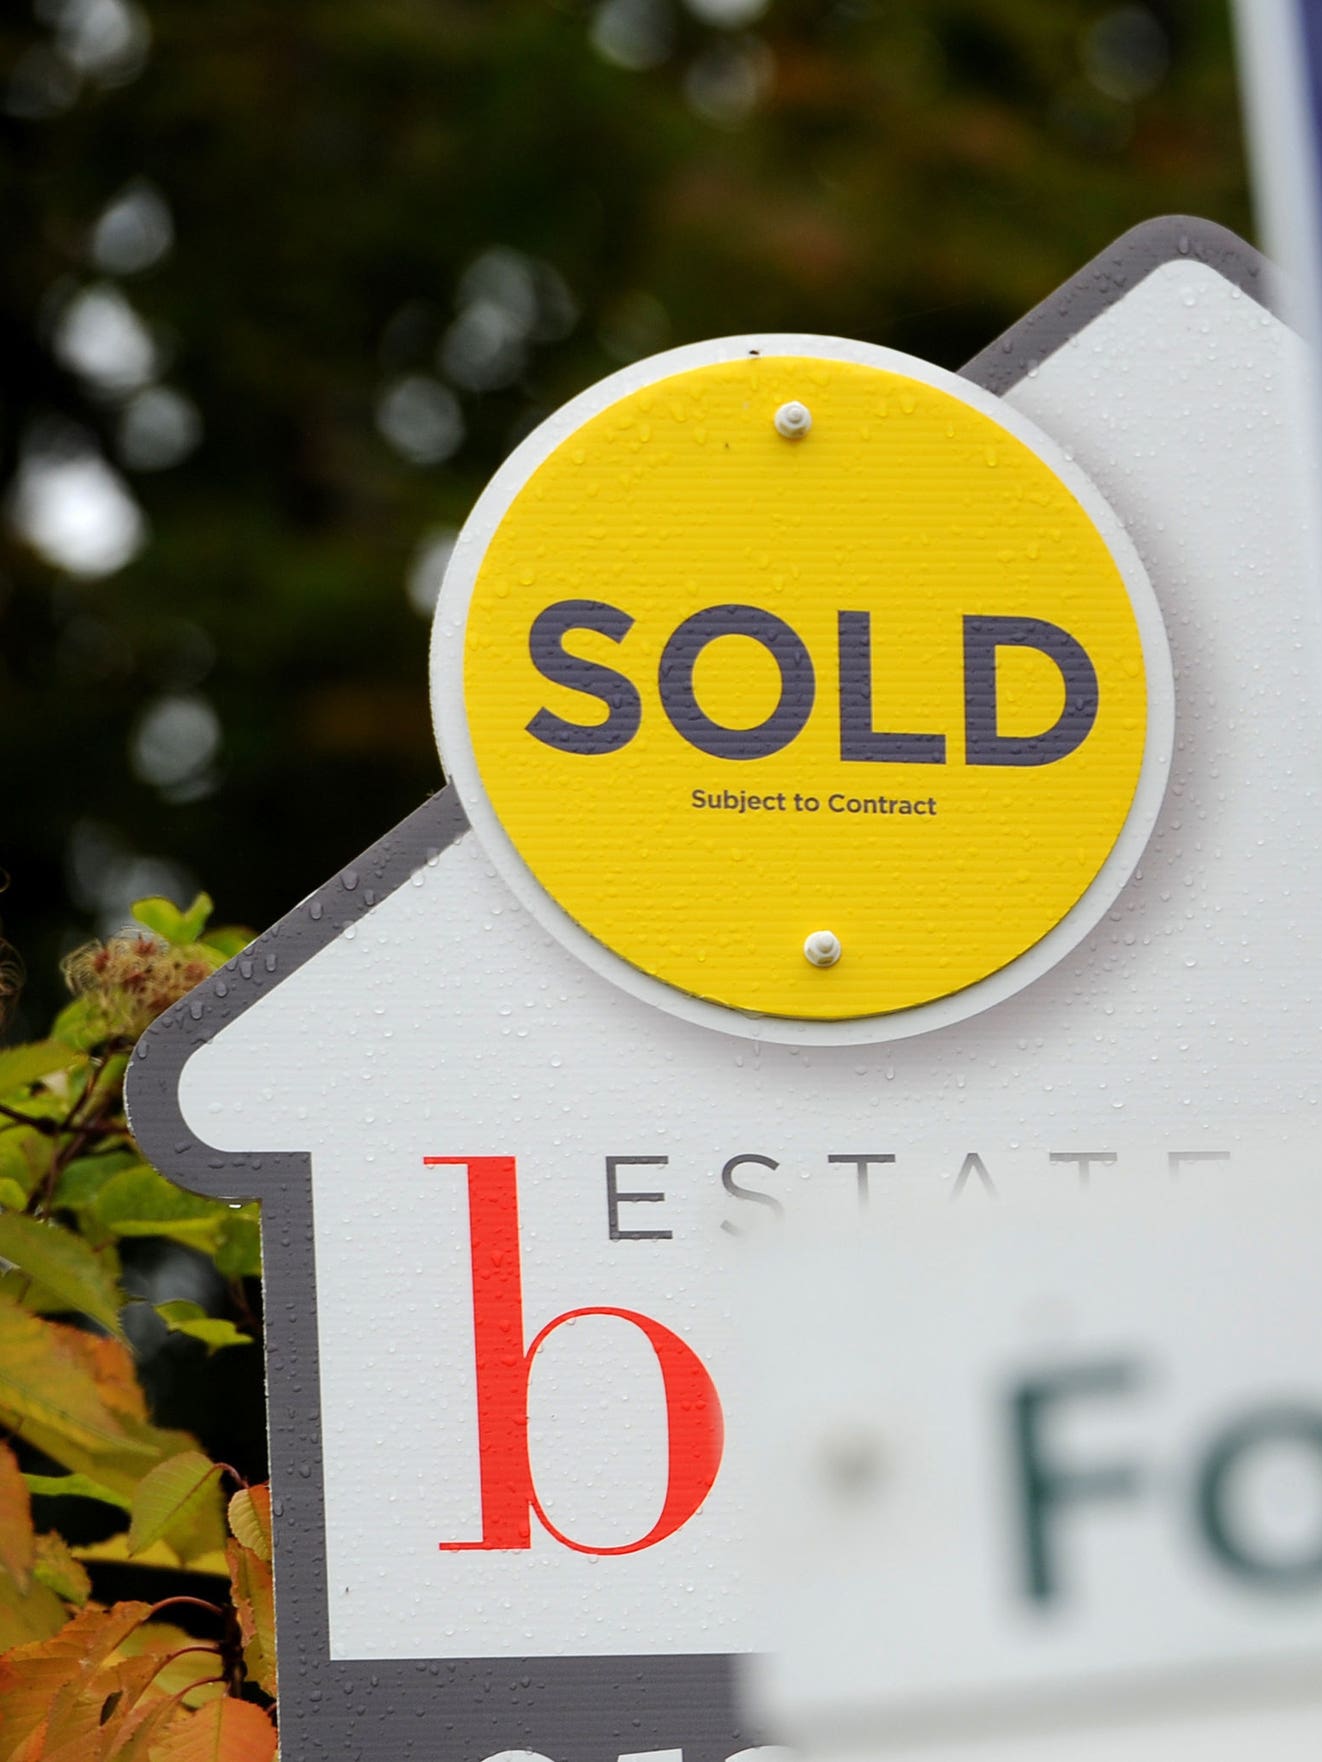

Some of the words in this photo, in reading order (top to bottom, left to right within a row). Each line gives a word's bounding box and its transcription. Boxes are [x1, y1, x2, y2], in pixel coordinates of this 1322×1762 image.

[524, 598, 1100, 767] SOLD
[691, 789, 786, 814] Subject
[793, 793, 820, 812] to
[828, 793, 937, 815] Contract
[422, 1155, 725, 1556] b
